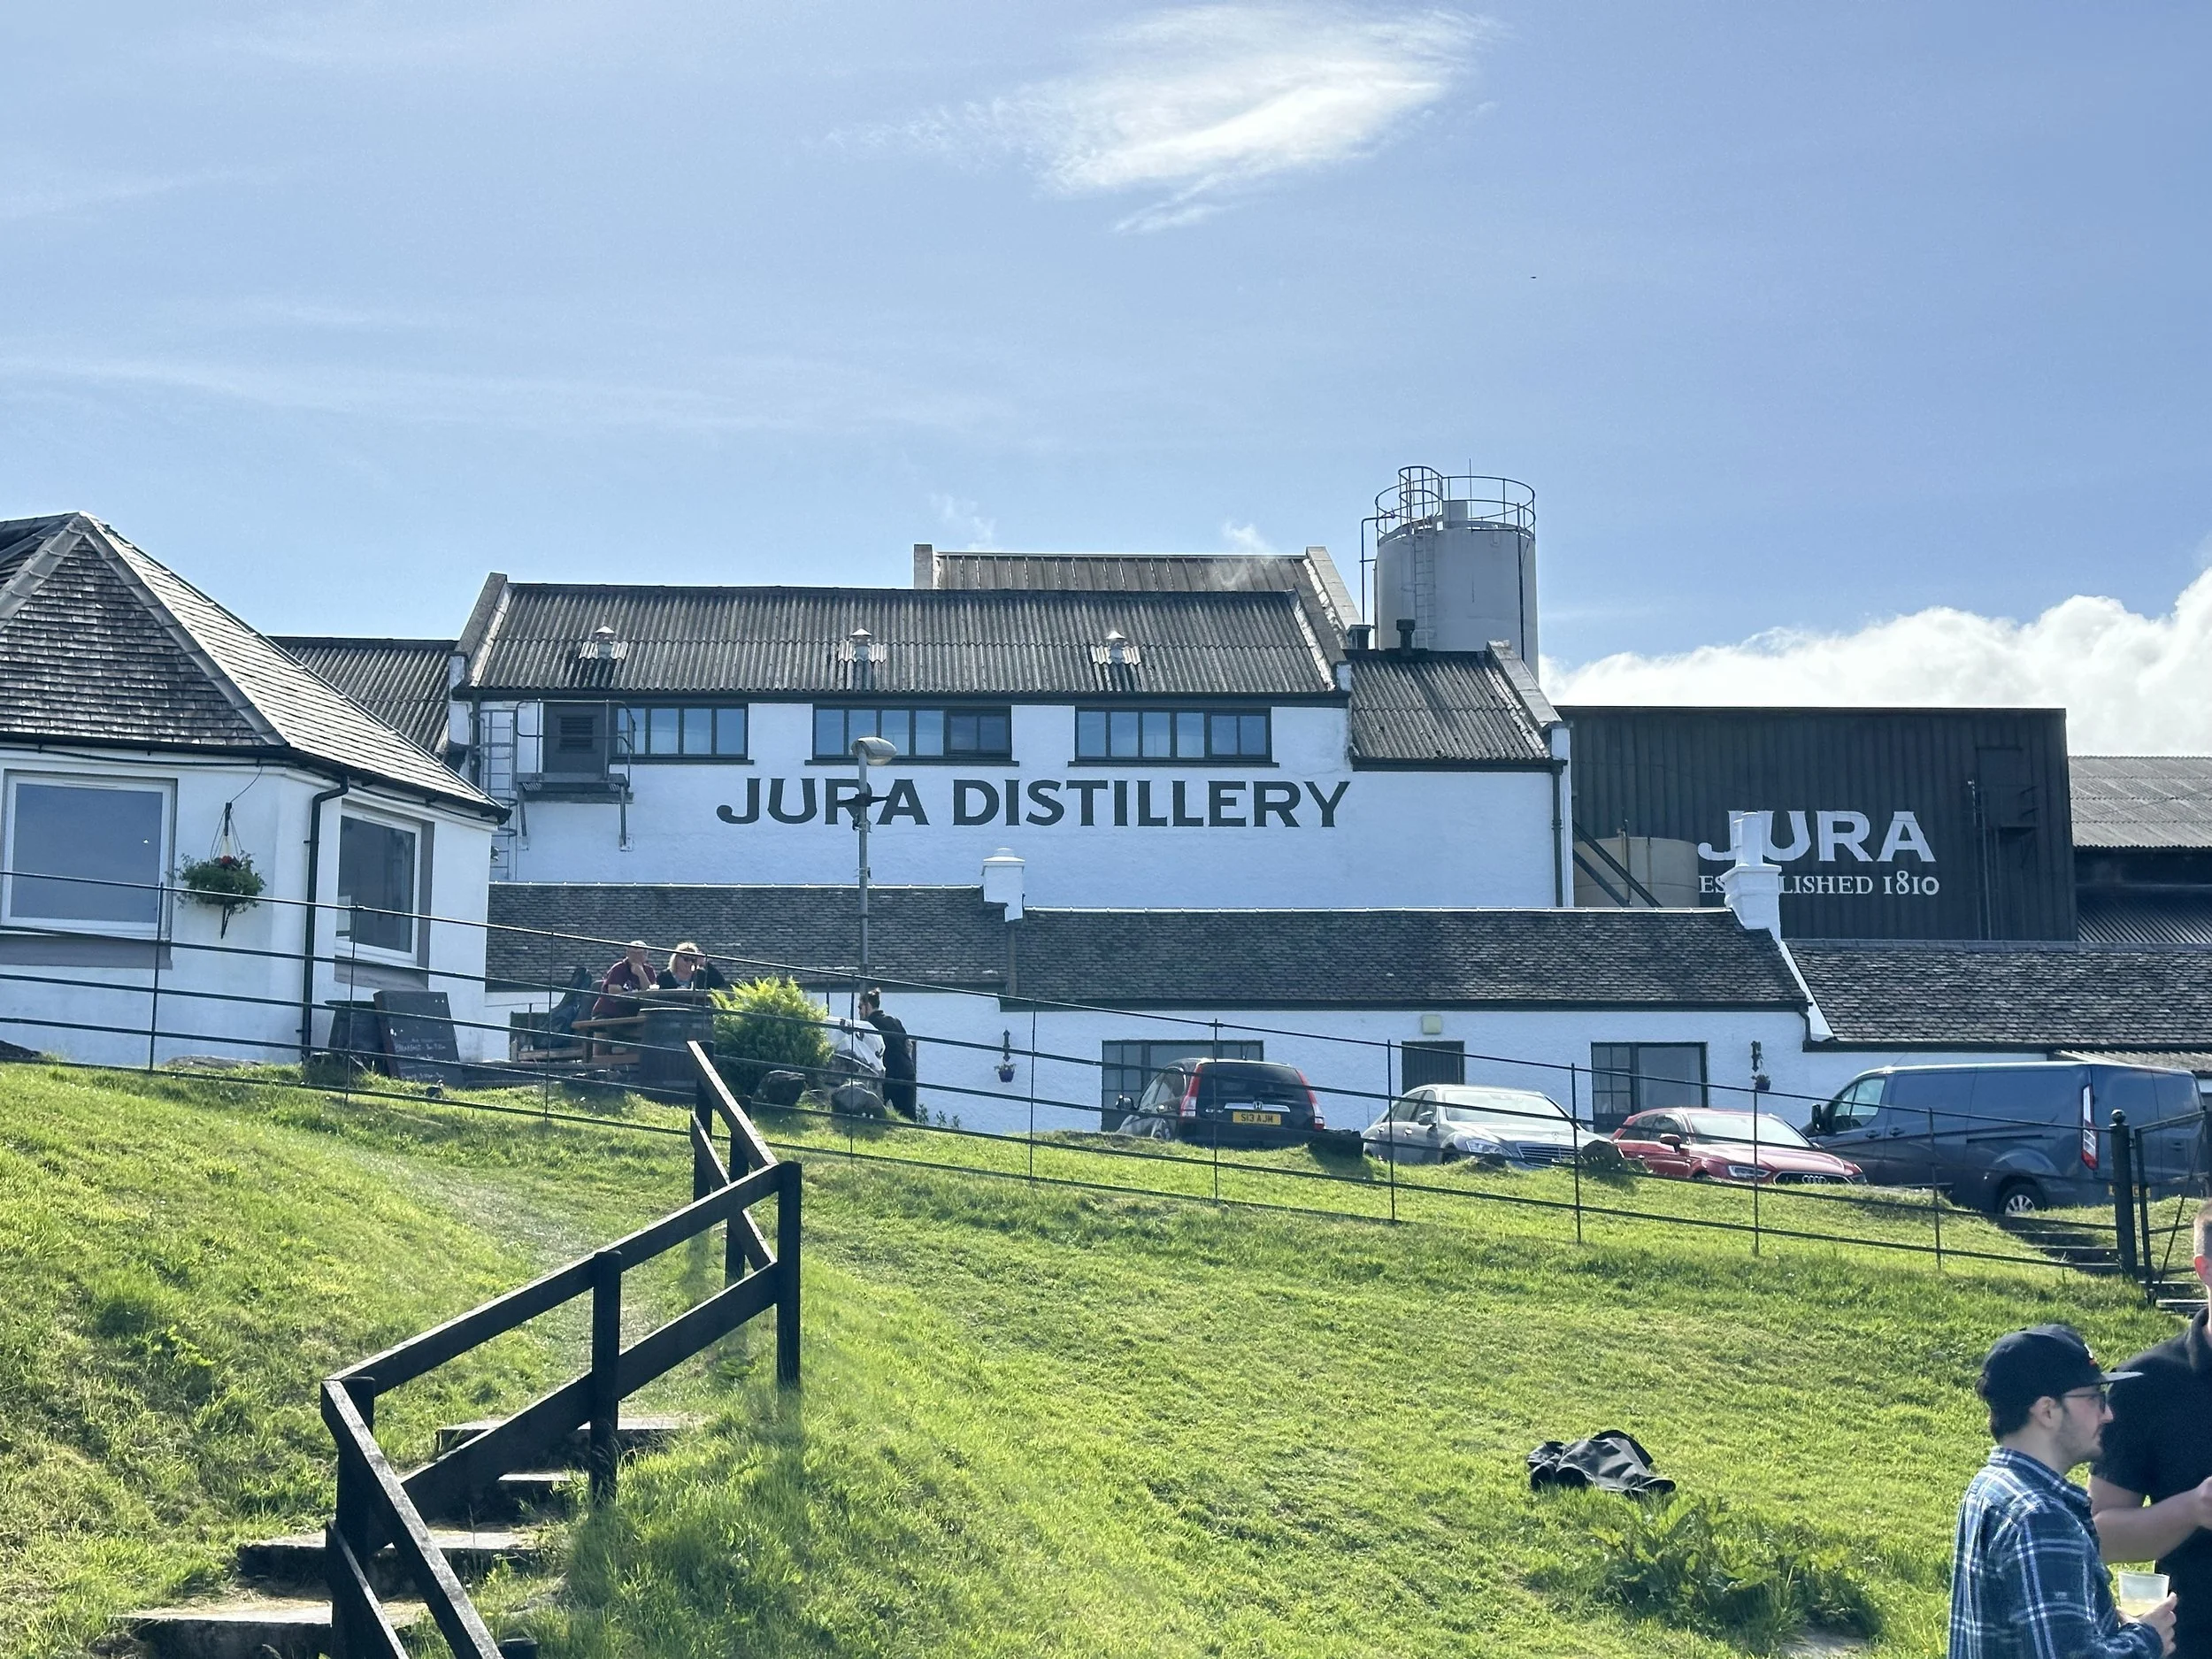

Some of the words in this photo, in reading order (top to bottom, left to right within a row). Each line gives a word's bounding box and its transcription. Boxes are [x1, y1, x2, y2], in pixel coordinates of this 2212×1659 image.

[716, 778, 930, 826] JURA
[952, 779, 1351, 828] DISTILLERY
[1697, 810, 1937, 863] JURA
[1699, 874, 1873, 895] ESLISHED
[1883, 870, 1940, 895] 1810
